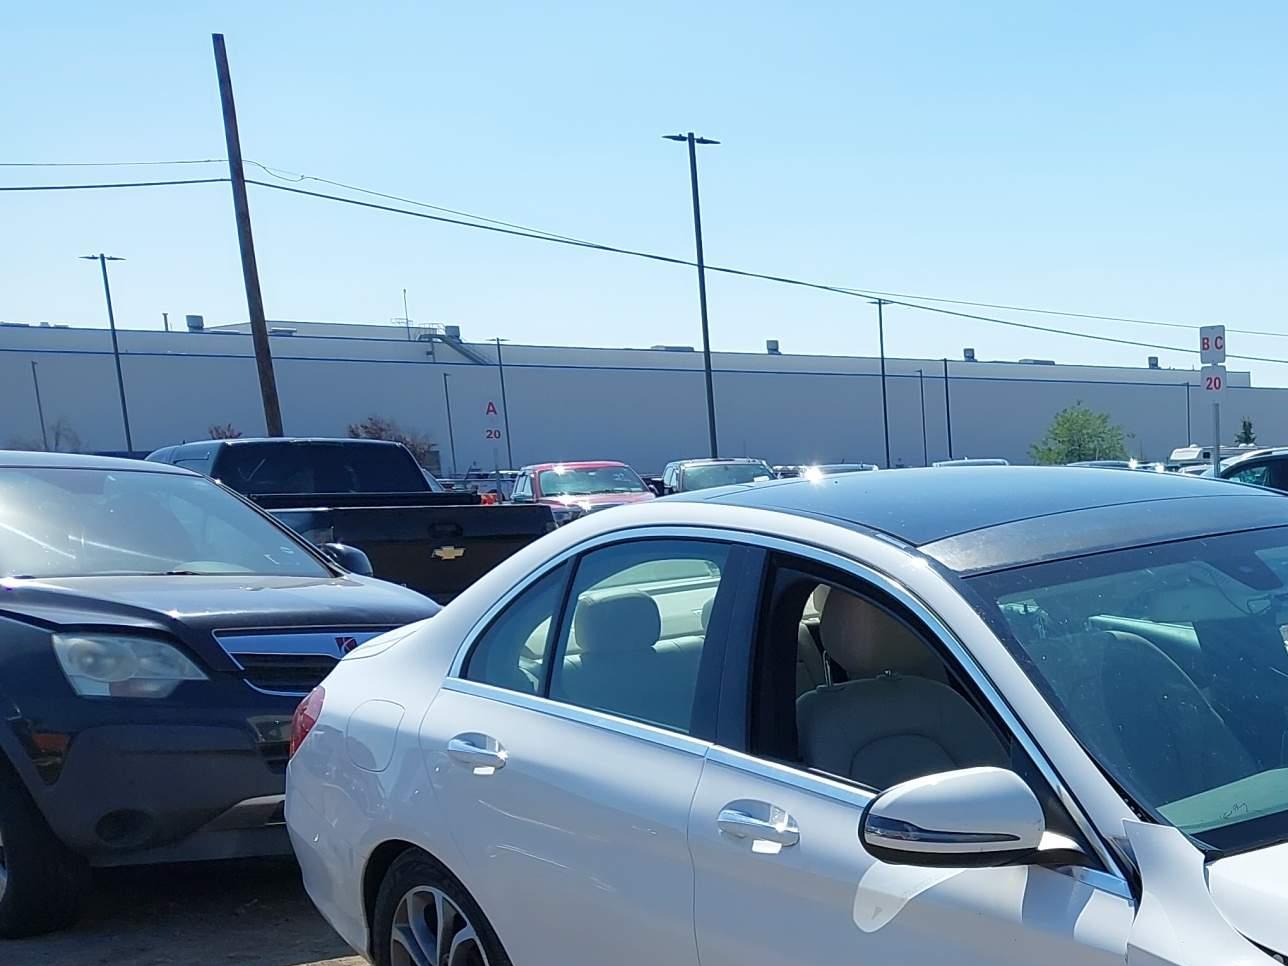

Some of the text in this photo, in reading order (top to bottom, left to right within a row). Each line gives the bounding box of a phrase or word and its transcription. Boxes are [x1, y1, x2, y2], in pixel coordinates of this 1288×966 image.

[1202, 336, 1223, 351] B C
[1205, 376, 1222, 391] 20
[486, 401, 497, 415] A
[486, 429, 501, 439] 20
